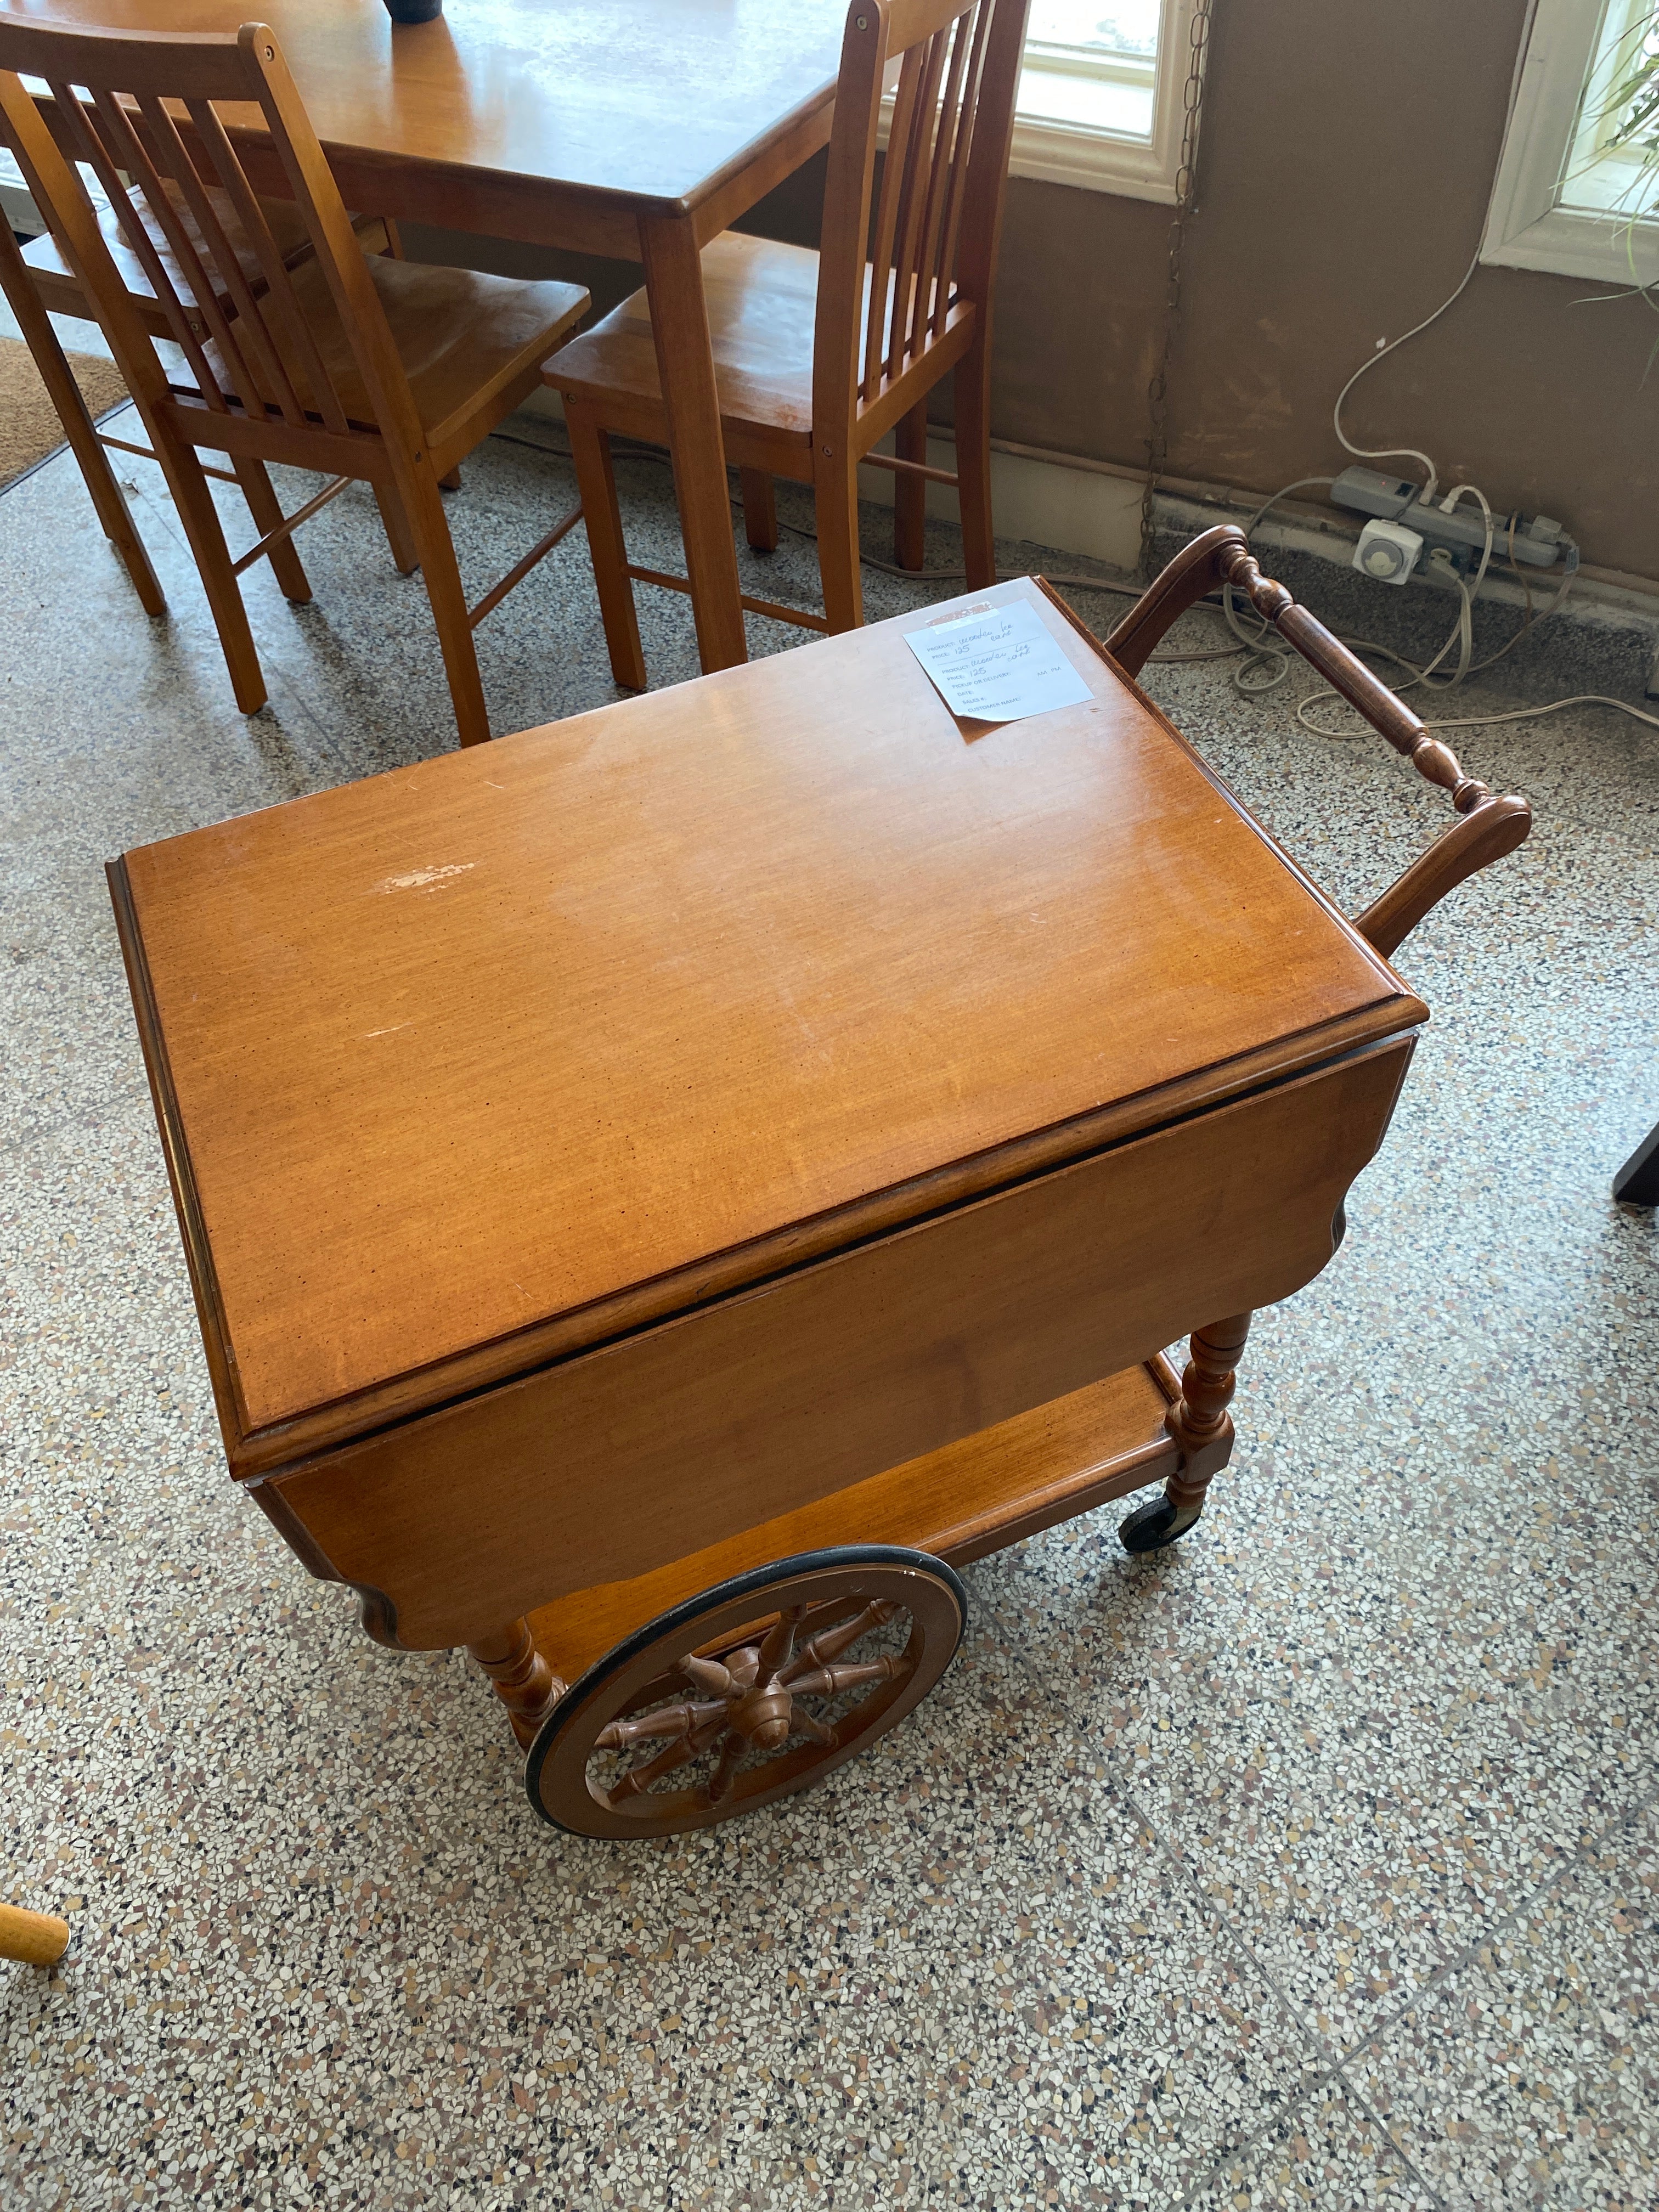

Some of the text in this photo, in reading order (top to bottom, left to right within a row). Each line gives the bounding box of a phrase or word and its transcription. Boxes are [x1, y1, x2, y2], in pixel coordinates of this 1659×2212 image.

[927, 642, 955, 652] PRODUCT:
[955, 644, 970, 654] 125
[941, 664, 969, 674] PRODUCT:
[970, 667, 986, 677] 125
[983, 672, 1011, 682] DELIVERY:
[968, 697, 1021, 713] CUSTOMER NAME:
